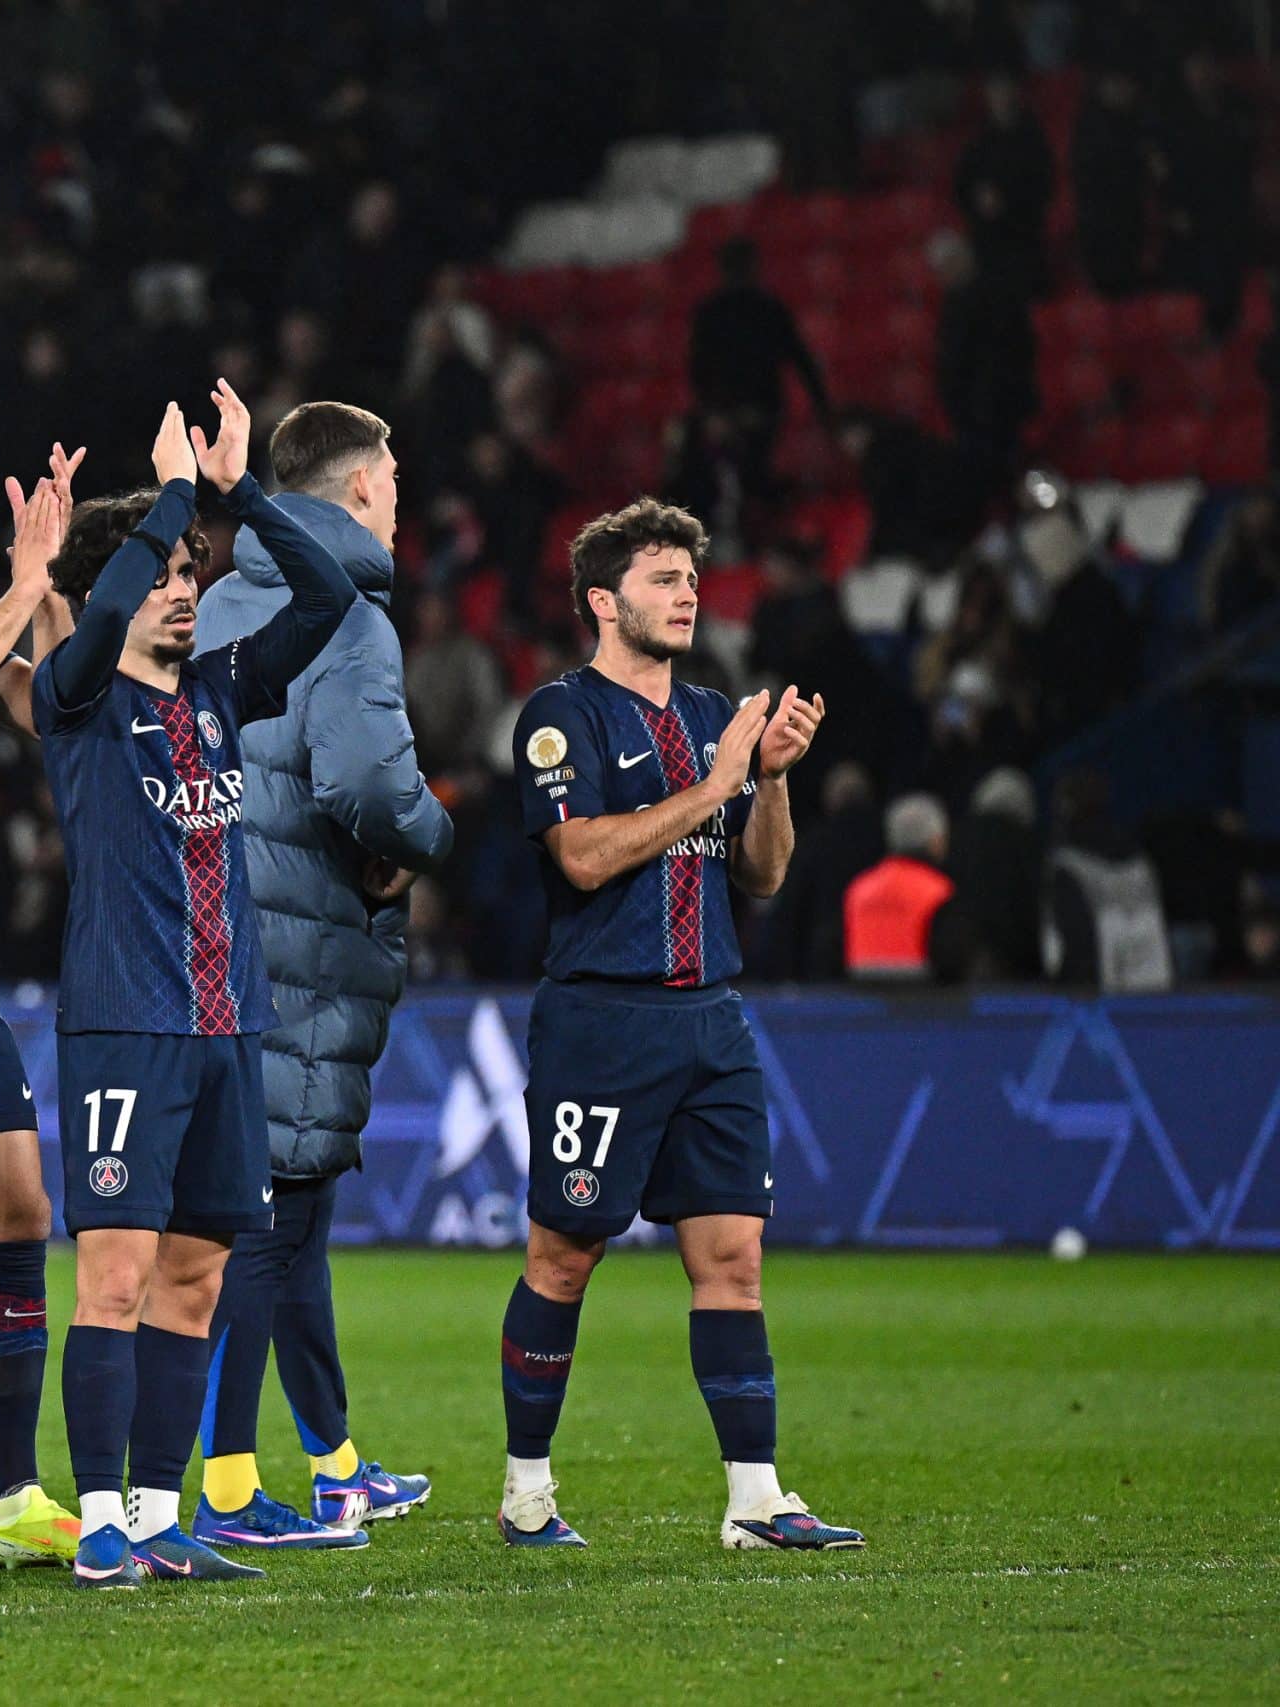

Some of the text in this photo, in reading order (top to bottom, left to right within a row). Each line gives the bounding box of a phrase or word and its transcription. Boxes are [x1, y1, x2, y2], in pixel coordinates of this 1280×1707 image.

[666, 836, 726, 859] IRWAYS
[83, 1088, 138, 1153] 17
[552, 1101, 620, 1168] 87
[94, 1158, 122, 1170] PARIS
[568, 1170, 595, 1182] PARIS
